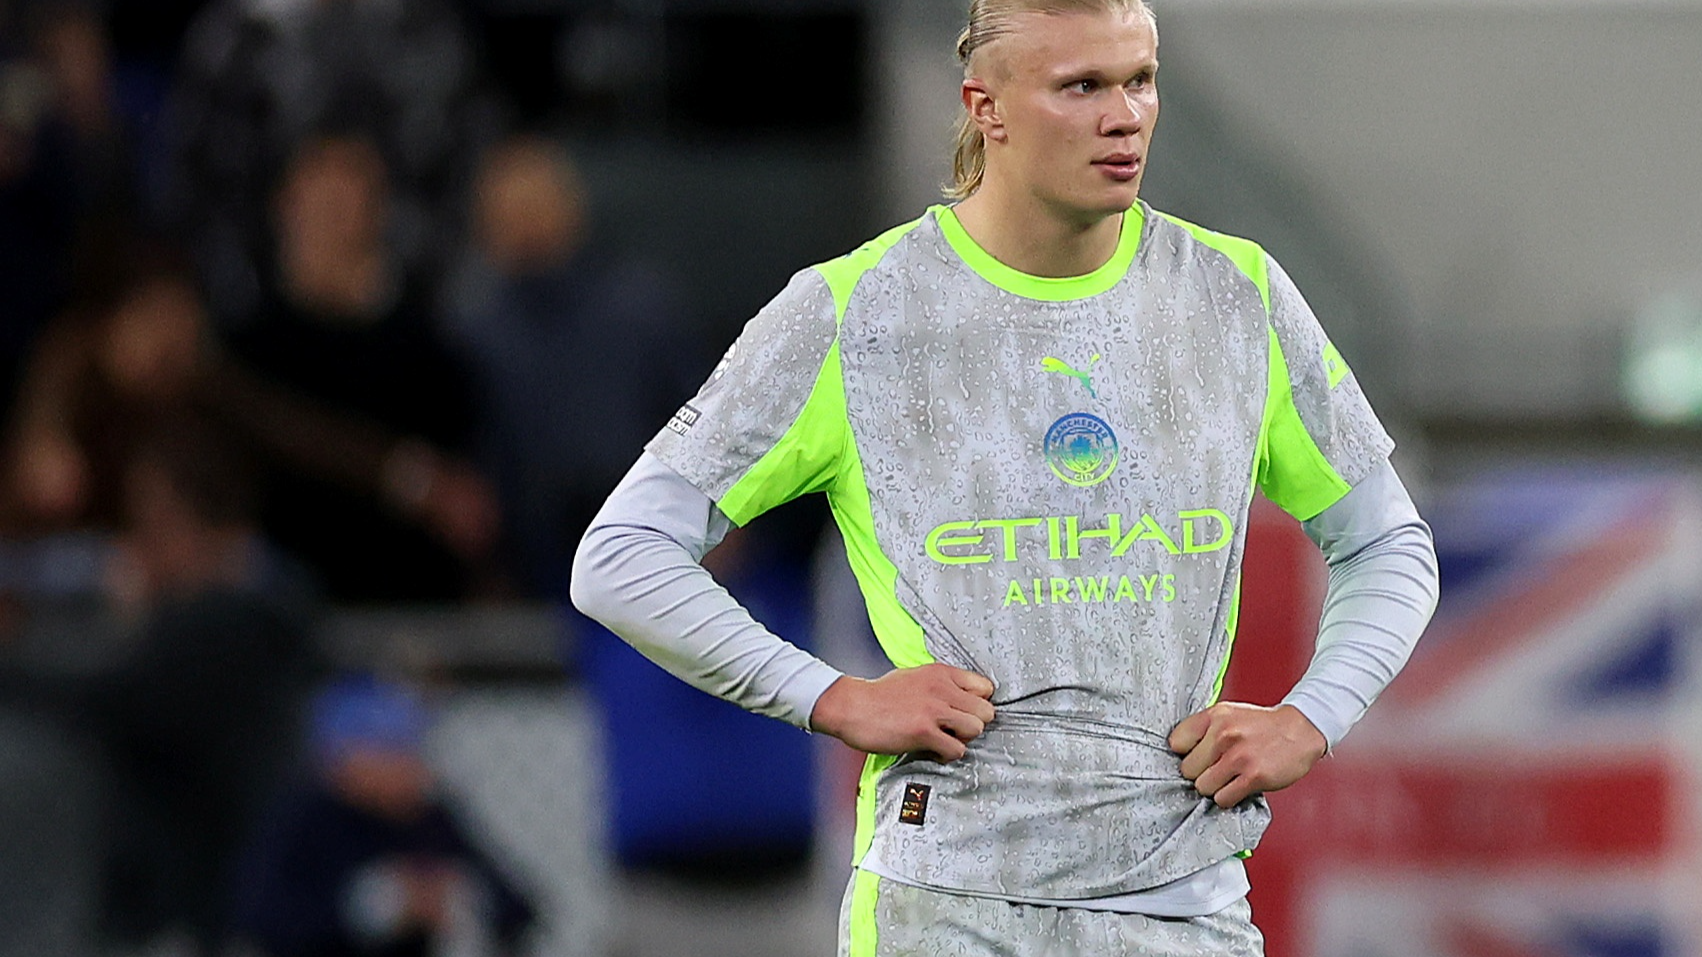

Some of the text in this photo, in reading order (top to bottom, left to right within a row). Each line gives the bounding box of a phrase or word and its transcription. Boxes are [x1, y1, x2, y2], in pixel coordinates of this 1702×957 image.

[1074, 472, 1096, 481] CITY
[924, 508, 1234, 565] ETIHAD
[1003, 573, 1177, 607] AIRWAYS
